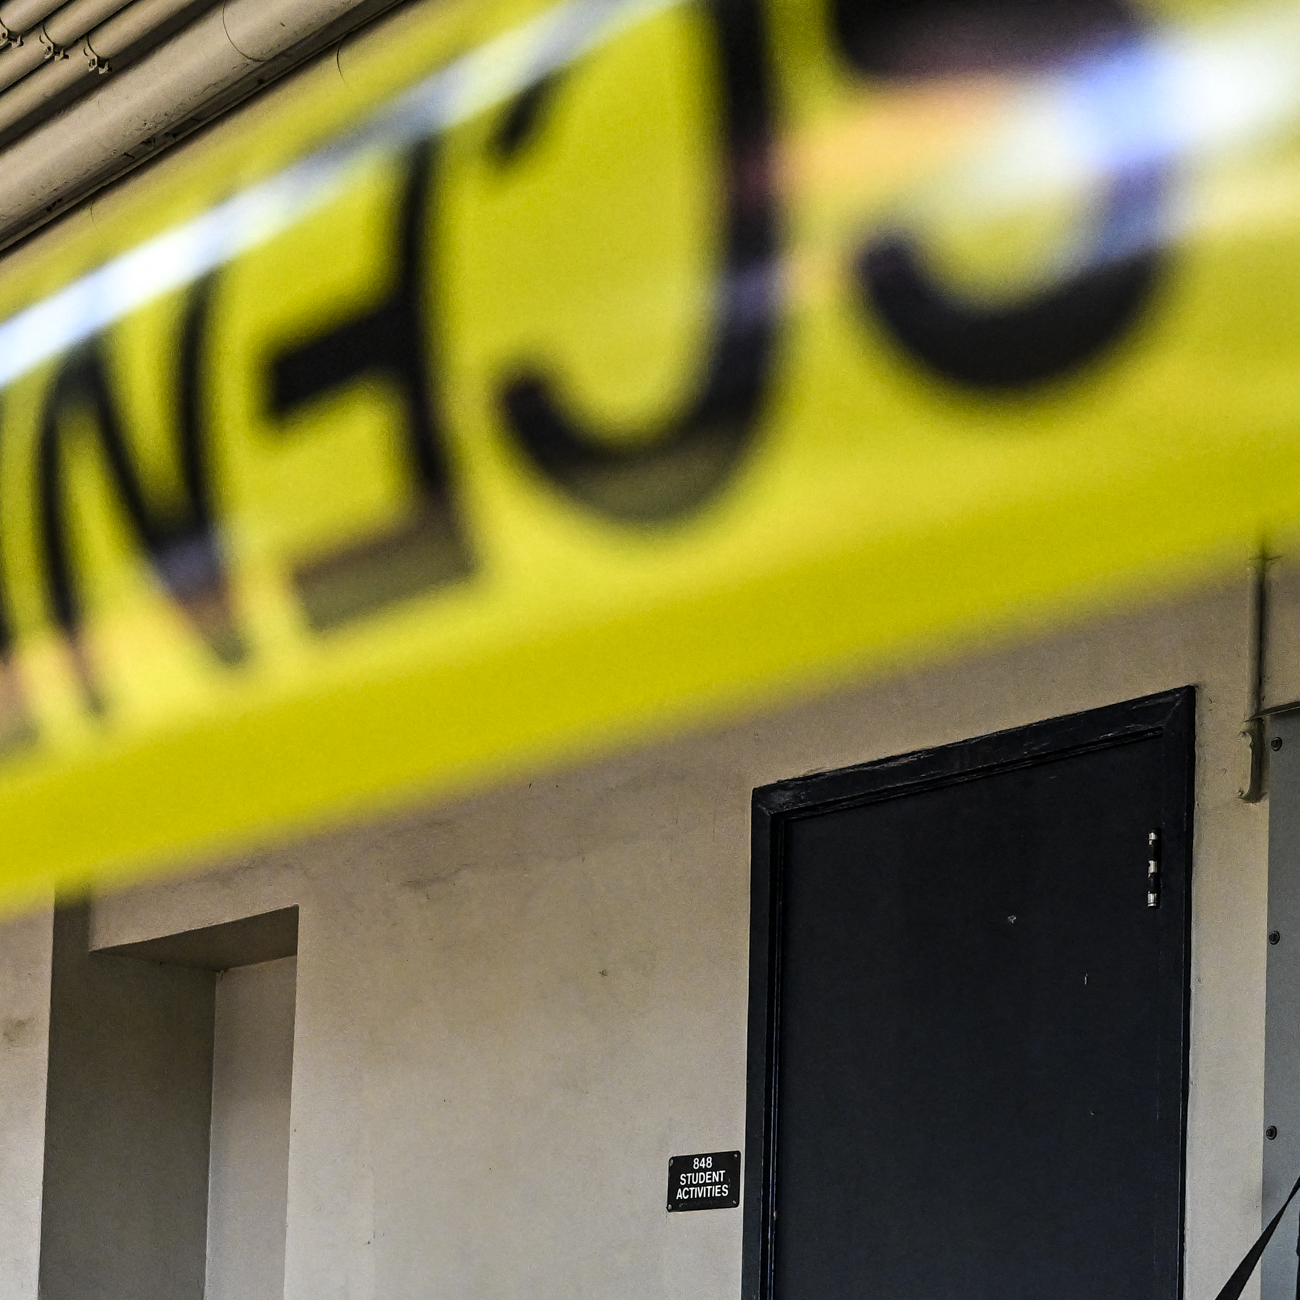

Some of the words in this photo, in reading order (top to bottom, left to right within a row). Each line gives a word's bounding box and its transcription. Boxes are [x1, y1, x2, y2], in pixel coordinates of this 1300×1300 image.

[693, 1156, 713, 1170] 848
[679, 1170, 726, 1186] STUDENT
[676, 1184, 729, 1200] ACTIVITIES
